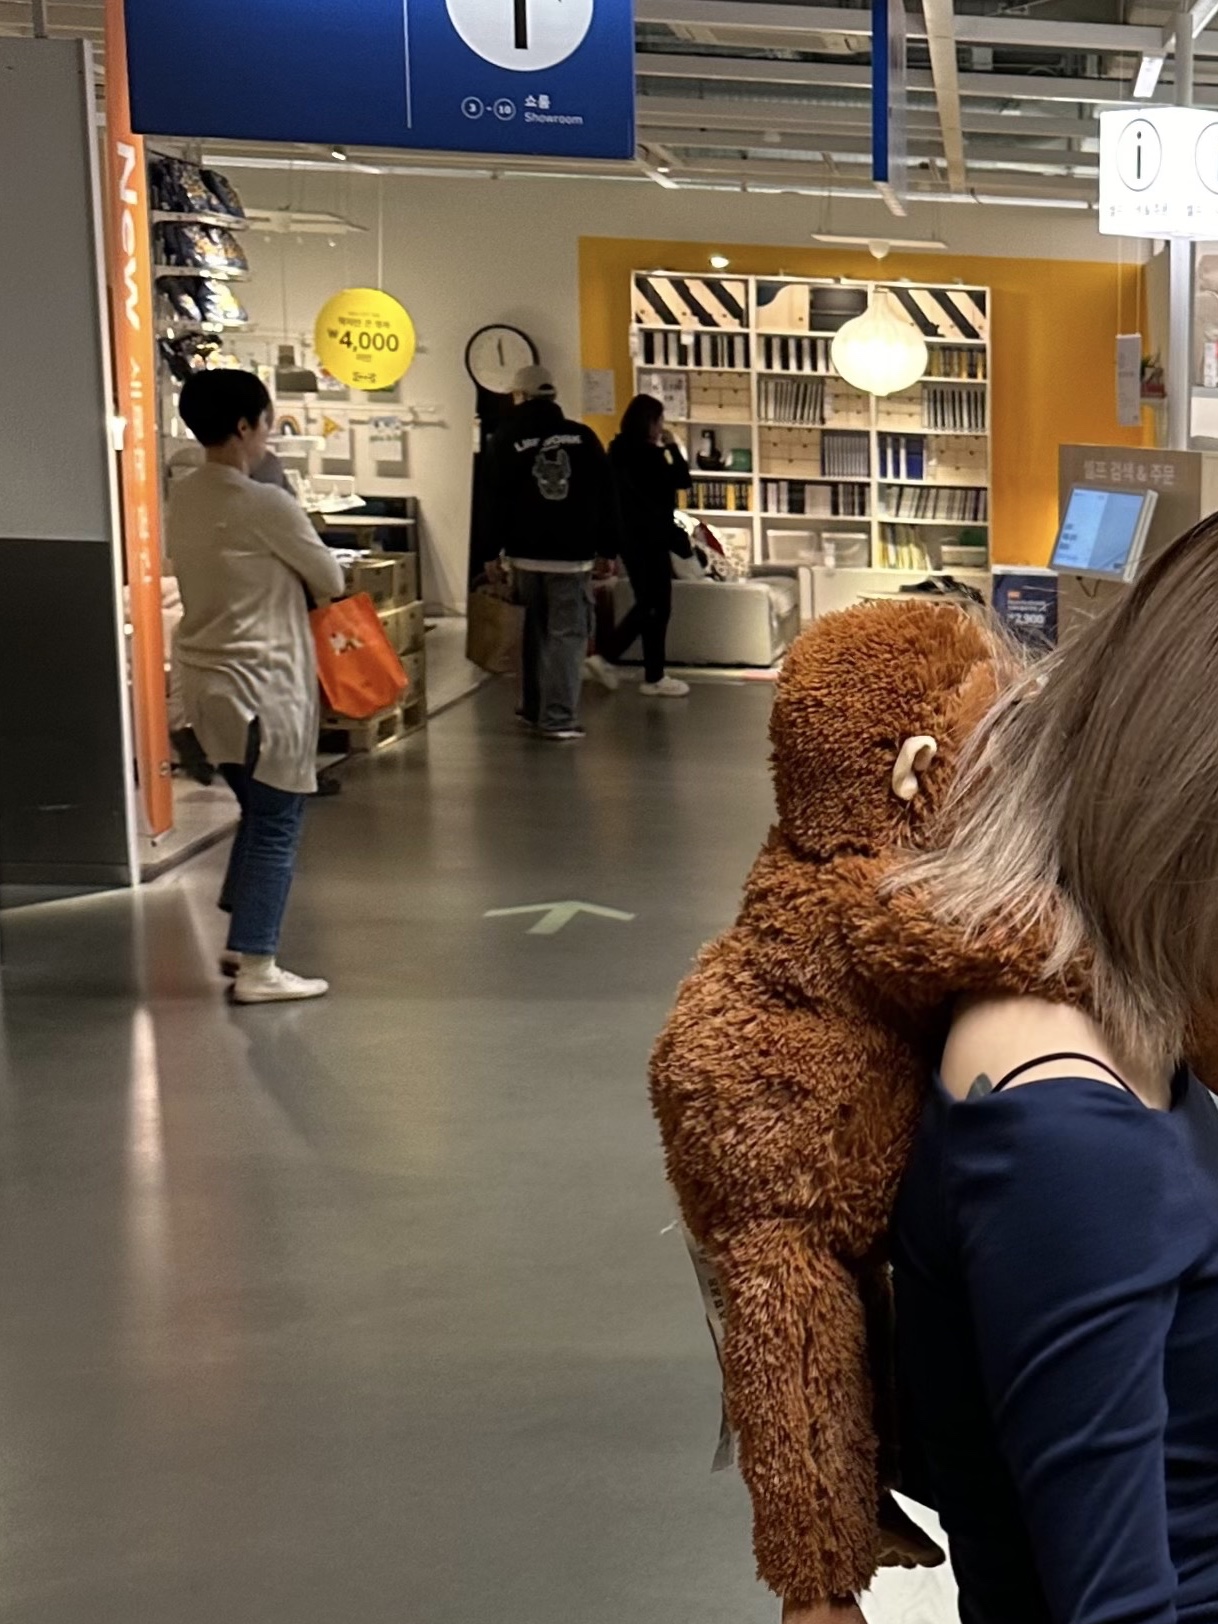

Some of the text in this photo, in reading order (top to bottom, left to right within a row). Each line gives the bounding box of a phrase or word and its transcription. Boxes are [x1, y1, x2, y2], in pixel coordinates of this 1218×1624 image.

[524, 112, 584, 125] Showroom
[116, 140, 141, 331] New
[1110, 460, 1134, 483] 검색
[1149, 463, 1175, 486] 주문
